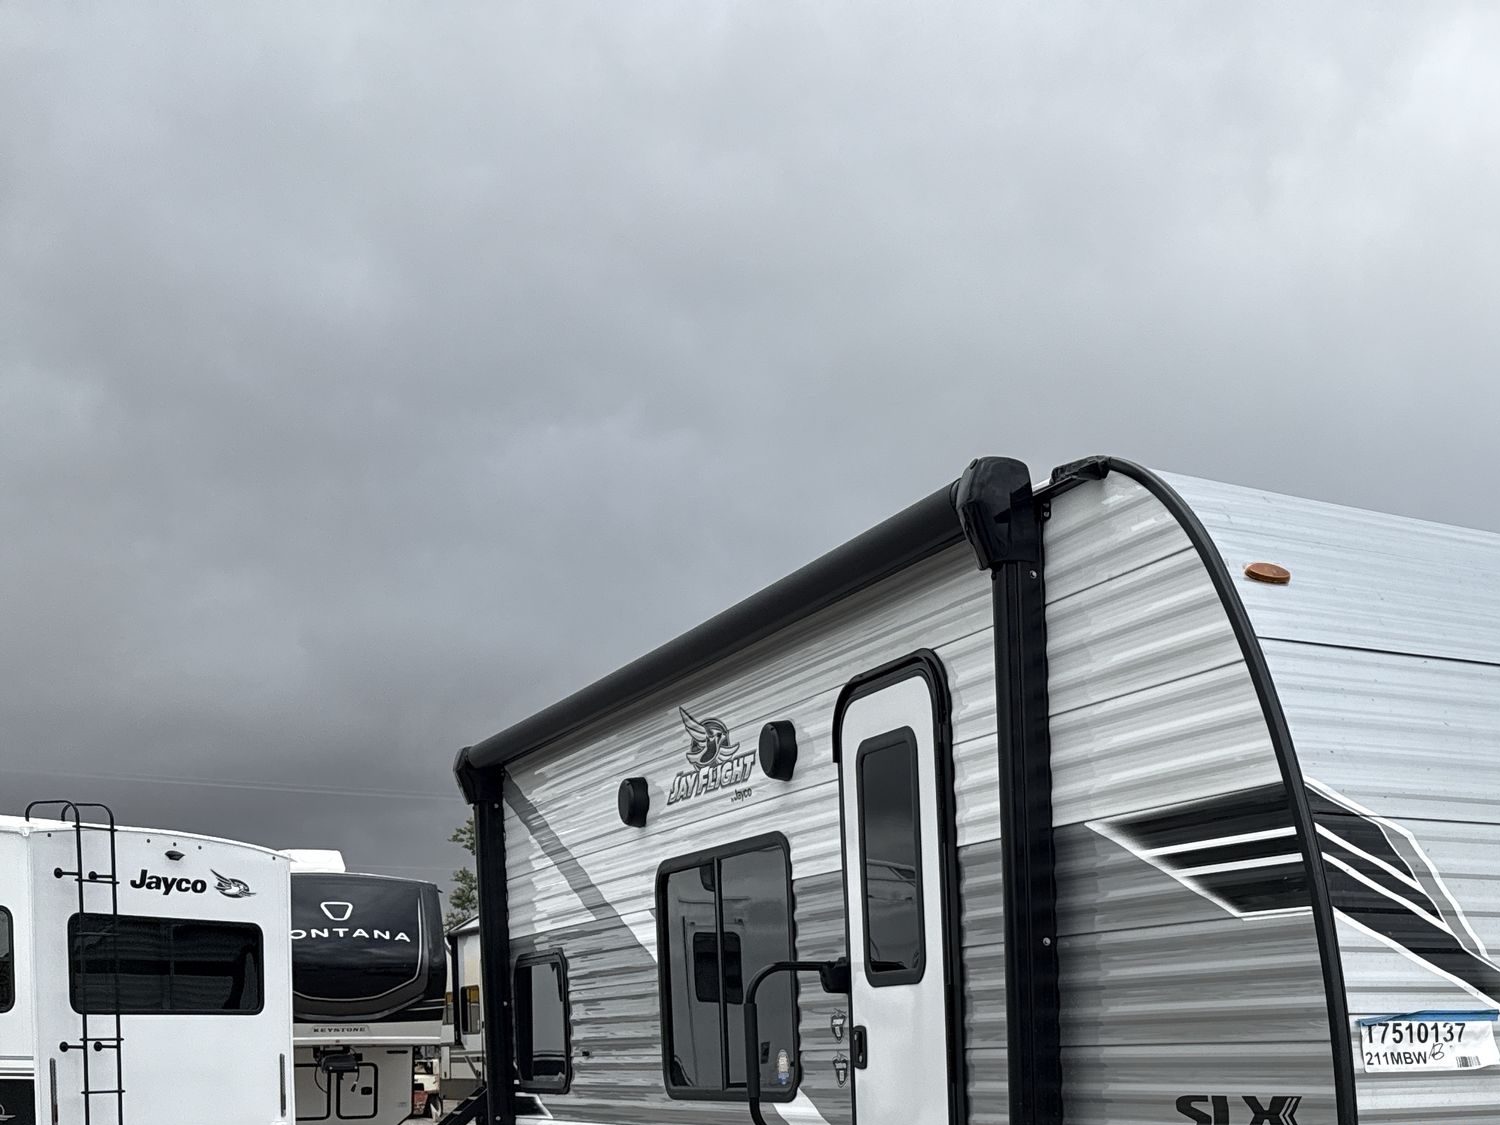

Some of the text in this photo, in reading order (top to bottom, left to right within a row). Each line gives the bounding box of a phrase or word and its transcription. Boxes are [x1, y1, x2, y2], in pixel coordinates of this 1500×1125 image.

[667, 751, 756, 805] JAY FLIGHT
[130, 869, 207, 895] Jayco
[290, 928, 411, 943] ONTANA
[1363, 1022, 1466, 1044] T7510137
[1365, 1051, 1427, 1066] 211MBW
